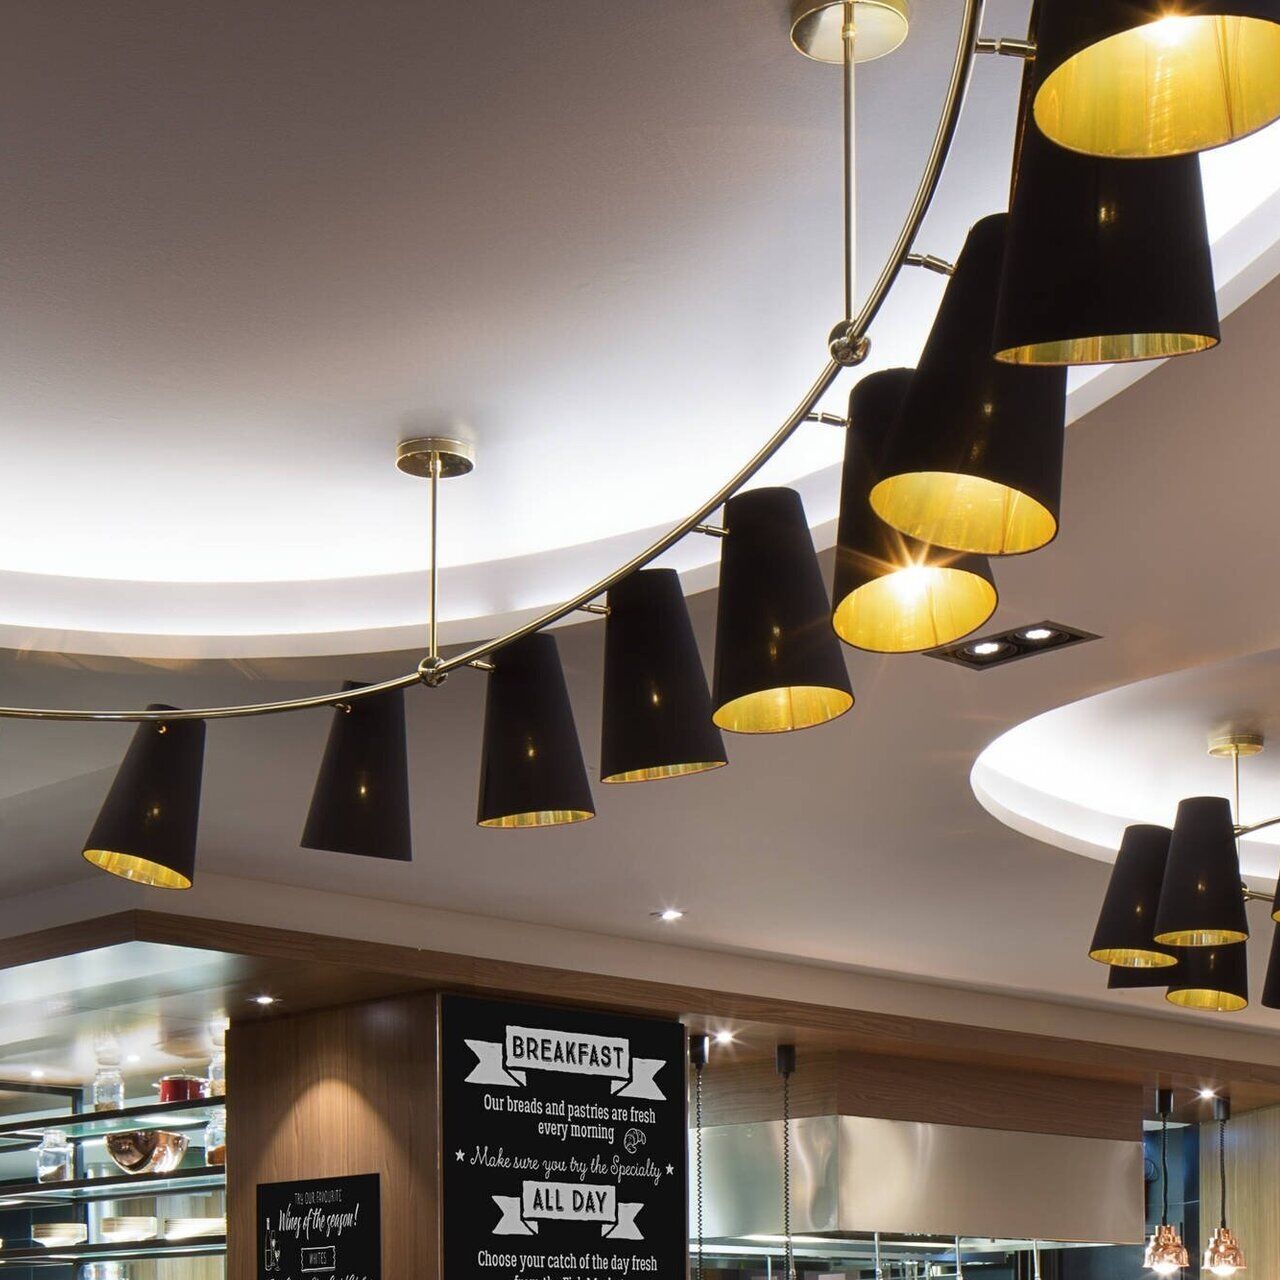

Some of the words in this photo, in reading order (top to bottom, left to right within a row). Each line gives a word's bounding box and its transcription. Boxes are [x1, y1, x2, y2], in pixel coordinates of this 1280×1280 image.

[512, 1036, 624, 1069] BREAKFAST
[484, 1094, 504, 1110] Our
[507, 1096, 542, 1114] breads
[546, 1100, 565, 1115] and
[568, 1104, 609, 1121] pastries
[612, 1109, 627, 1121] are
[631, 1107, 655, 1123] fresh
[538, 1122, 568, 1141] every
[571, 1125, 614, 1144] morning
[470, 1146, 511, 1168] Make
[513, 1157, 539, 1170] sure
[542, 1160, 567, 1179] you
[570, 1157, 588, 1181] try
[591, 1155, 608, 1174] the
[611, 1155, 661, 1185] Specialty
[533, 1188, 564, 1212] ALL
[573, 1190, 608, 1213] DAY
[279, 1203, 301, 1239] Wines
[303, 1208, 313, 1240] of
[313, 1208, 326, 1232] the
[326, 1203, 359, 1238] season!
[309, 1252, 327, 1264] WHITES
[478, 1250, 517, 1267] Choose
[520, 1255, 545, 1272] your
[548, 1253, 577, 1268] catch
[579, 1254, 590, 1269] of
[592, 1254, 608, 1269] the
[611, 1255, 629, 1275] day
[632, 1255, 657, 1271] fresh
